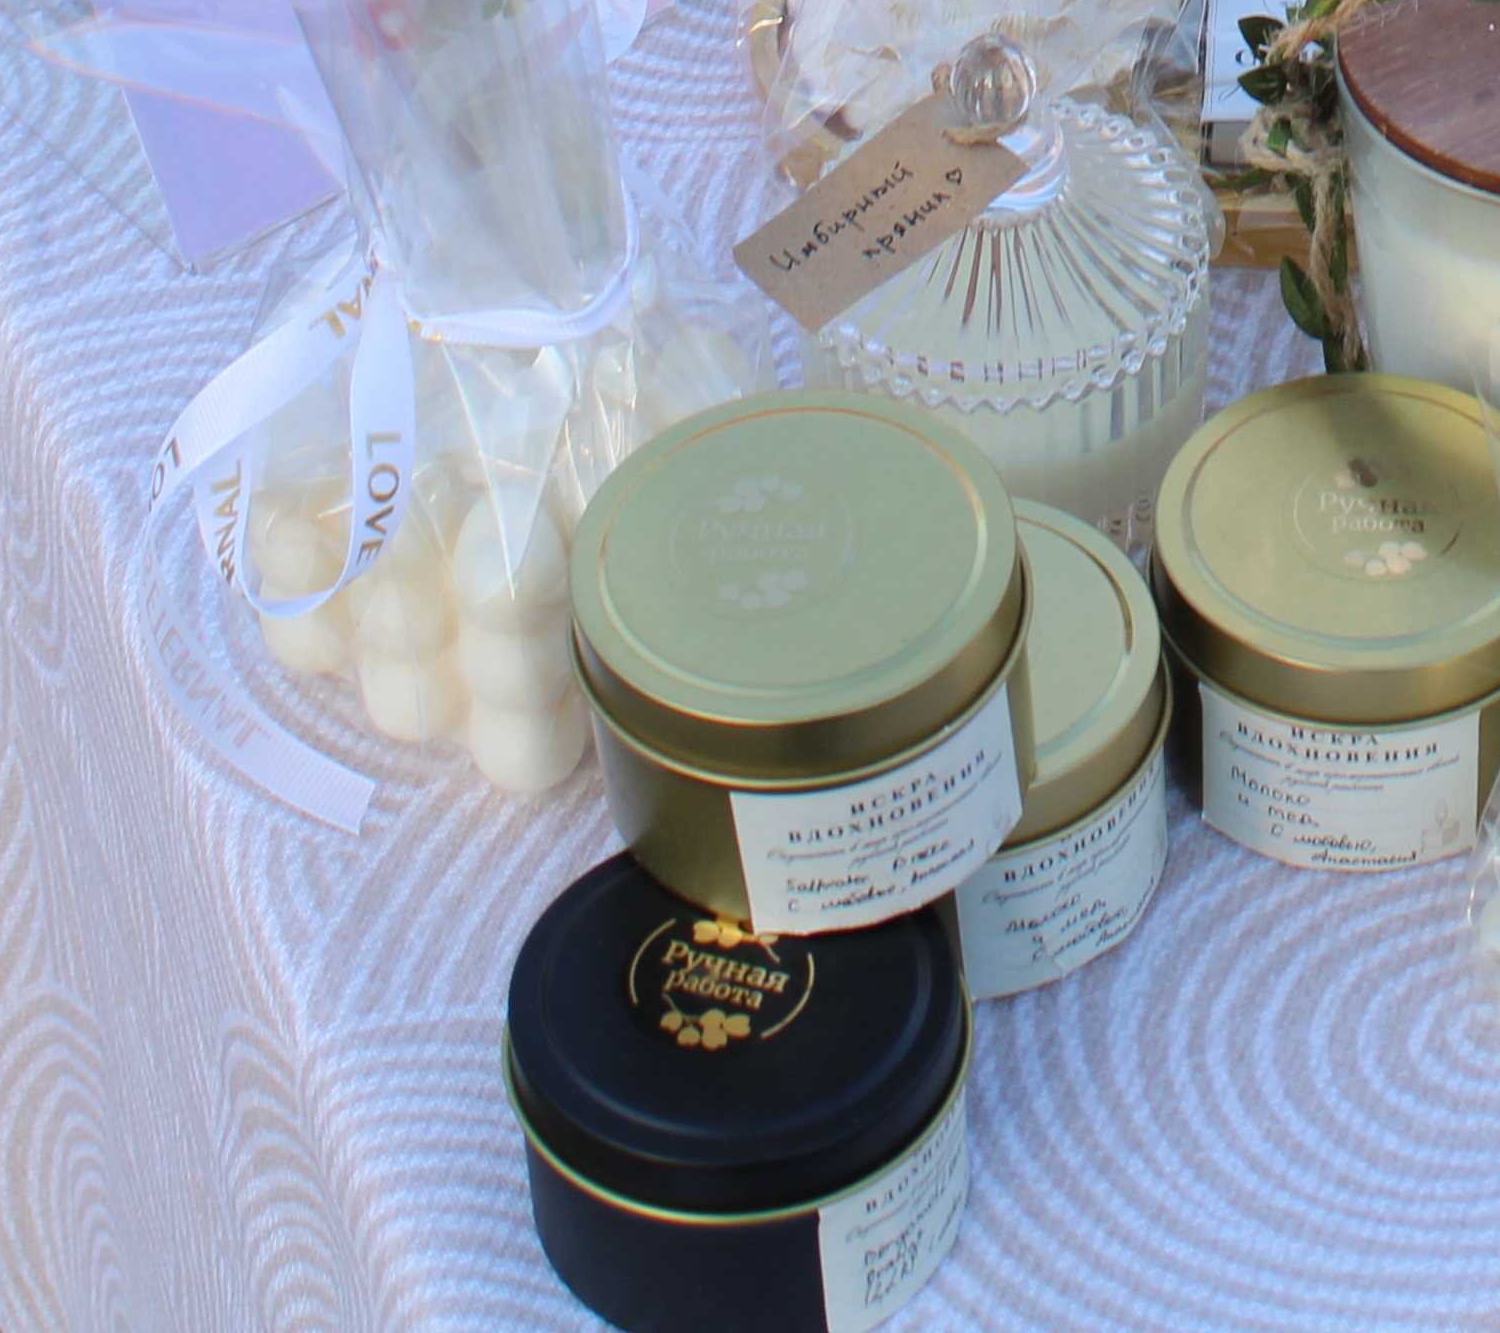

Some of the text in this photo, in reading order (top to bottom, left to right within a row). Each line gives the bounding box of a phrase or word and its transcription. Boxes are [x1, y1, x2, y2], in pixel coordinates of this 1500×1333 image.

[862, 191, 952, 262] пряник
[356, 431, 402, 567] LOVE
[1237, 721, 1438, 763] ВДОХНОВЕНИЯ
[1290, 726, 1380, 746] ИСКРА
[788, 748, 986, 845] ВДОХНОВЕНИЯ
[850, 770, 939, 817] ИСКРА
[1230, 764, 1311, 806] Молоко
[661, 938, 791, 995] Ручная
[662, 968, 764, 1012] работа
